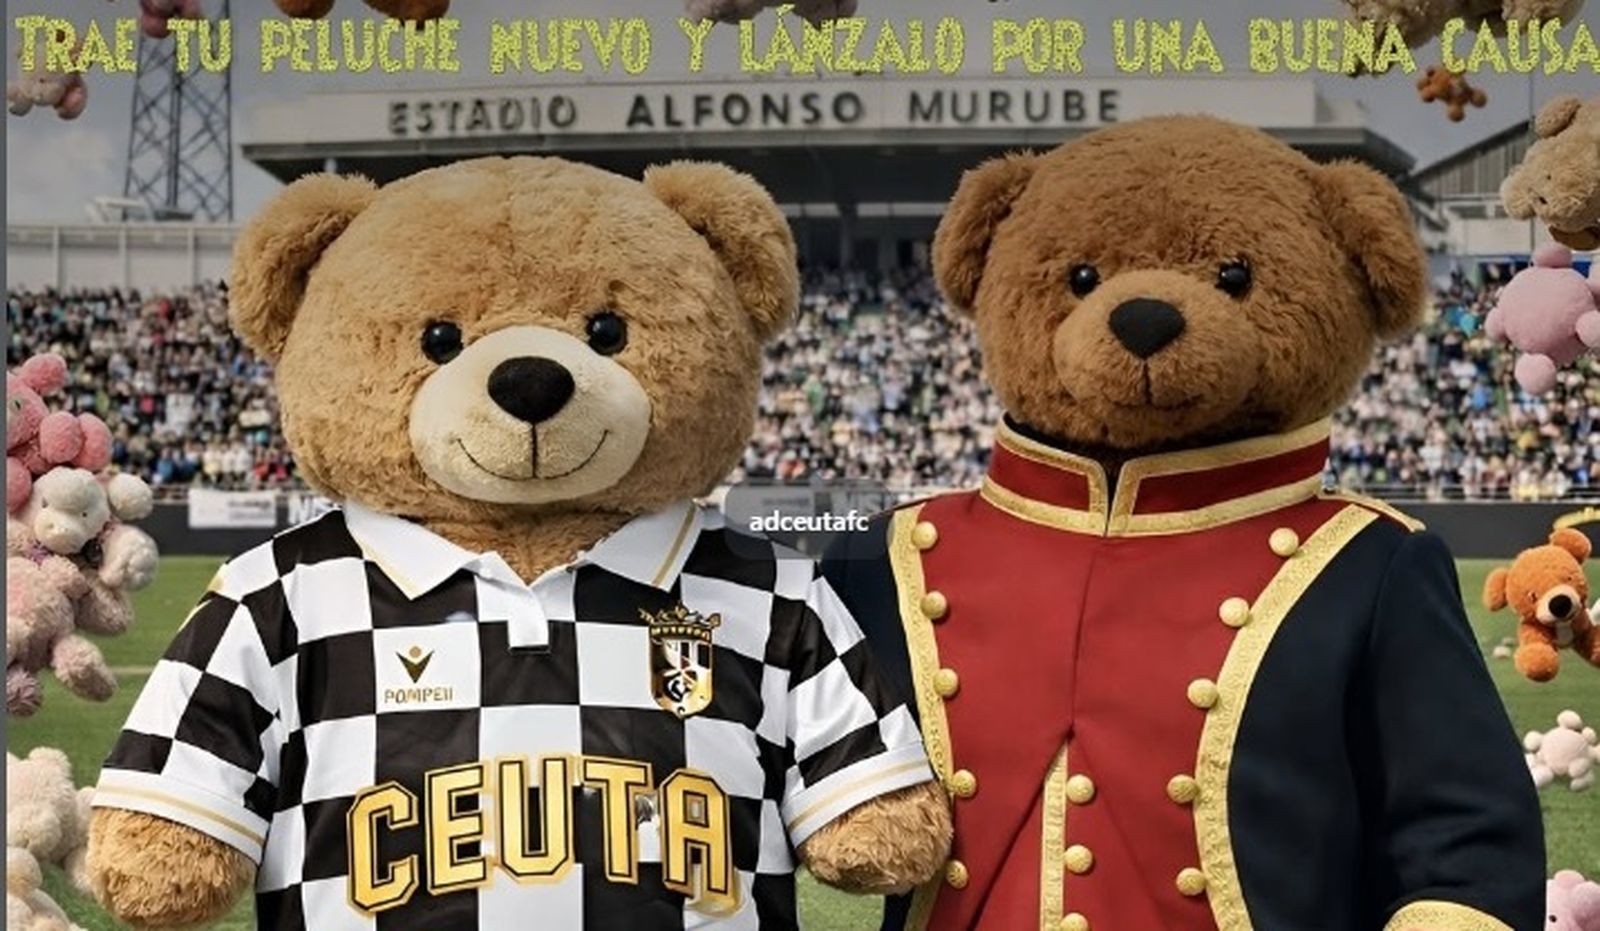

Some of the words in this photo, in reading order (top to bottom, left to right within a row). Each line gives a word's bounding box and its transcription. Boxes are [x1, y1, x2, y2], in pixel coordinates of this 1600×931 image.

[389, 96, 578, 135] ESTADIO
[626, 91, 866, 127] ALFONSO
[907, 88, 1121, 124] MURUBE
[346, 752, 739, 918] CEUTA
